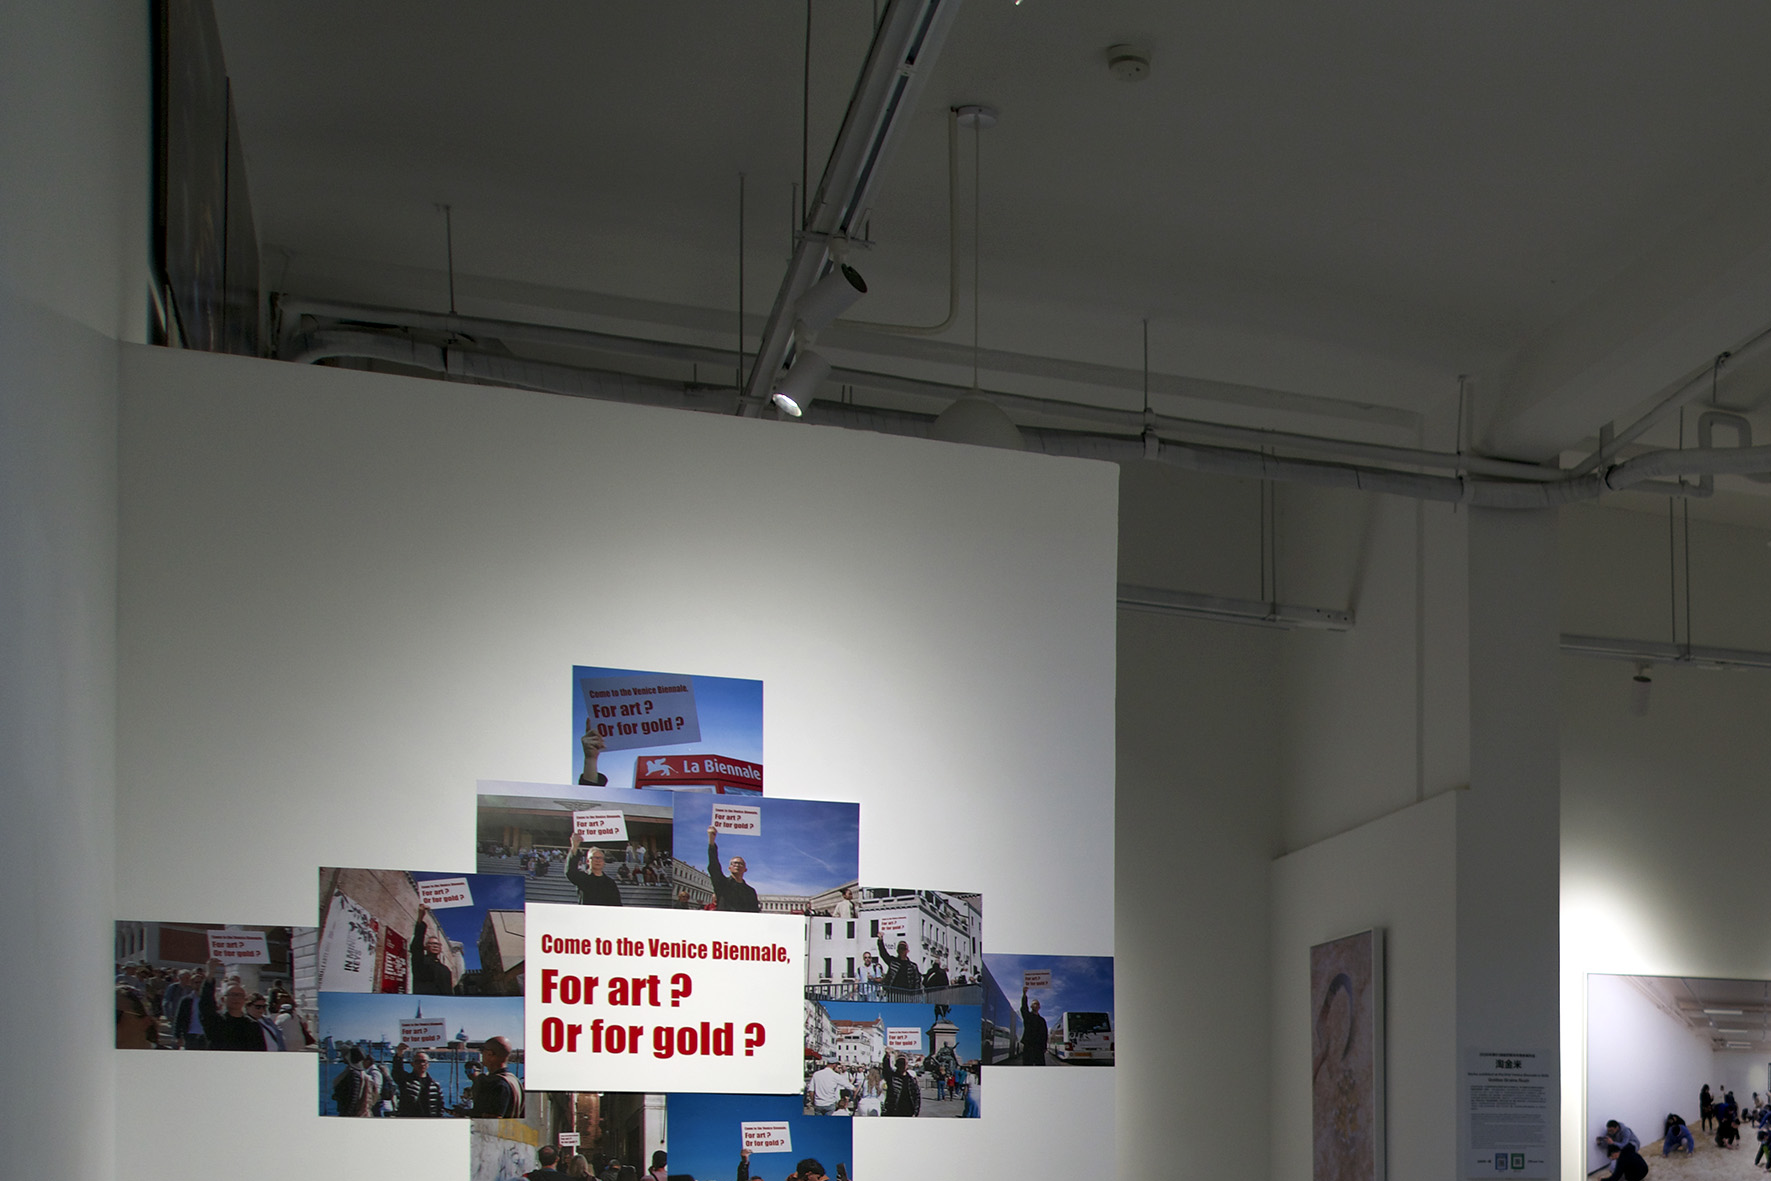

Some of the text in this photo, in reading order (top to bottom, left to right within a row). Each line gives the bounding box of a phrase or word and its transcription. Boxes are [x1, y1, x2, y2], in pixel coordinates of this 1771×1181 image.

[592, 700, 654, 718] For art ?
[597, 716, 684, 737] Or for gold ?
[683, 758, 762, 781] La Biennale
[541, 934, 791, 964] Come to the Venice Biennale,
[541, 969, 692, 1007] For art ?
[541, 1017, 766, 1059] Or for gold ?
